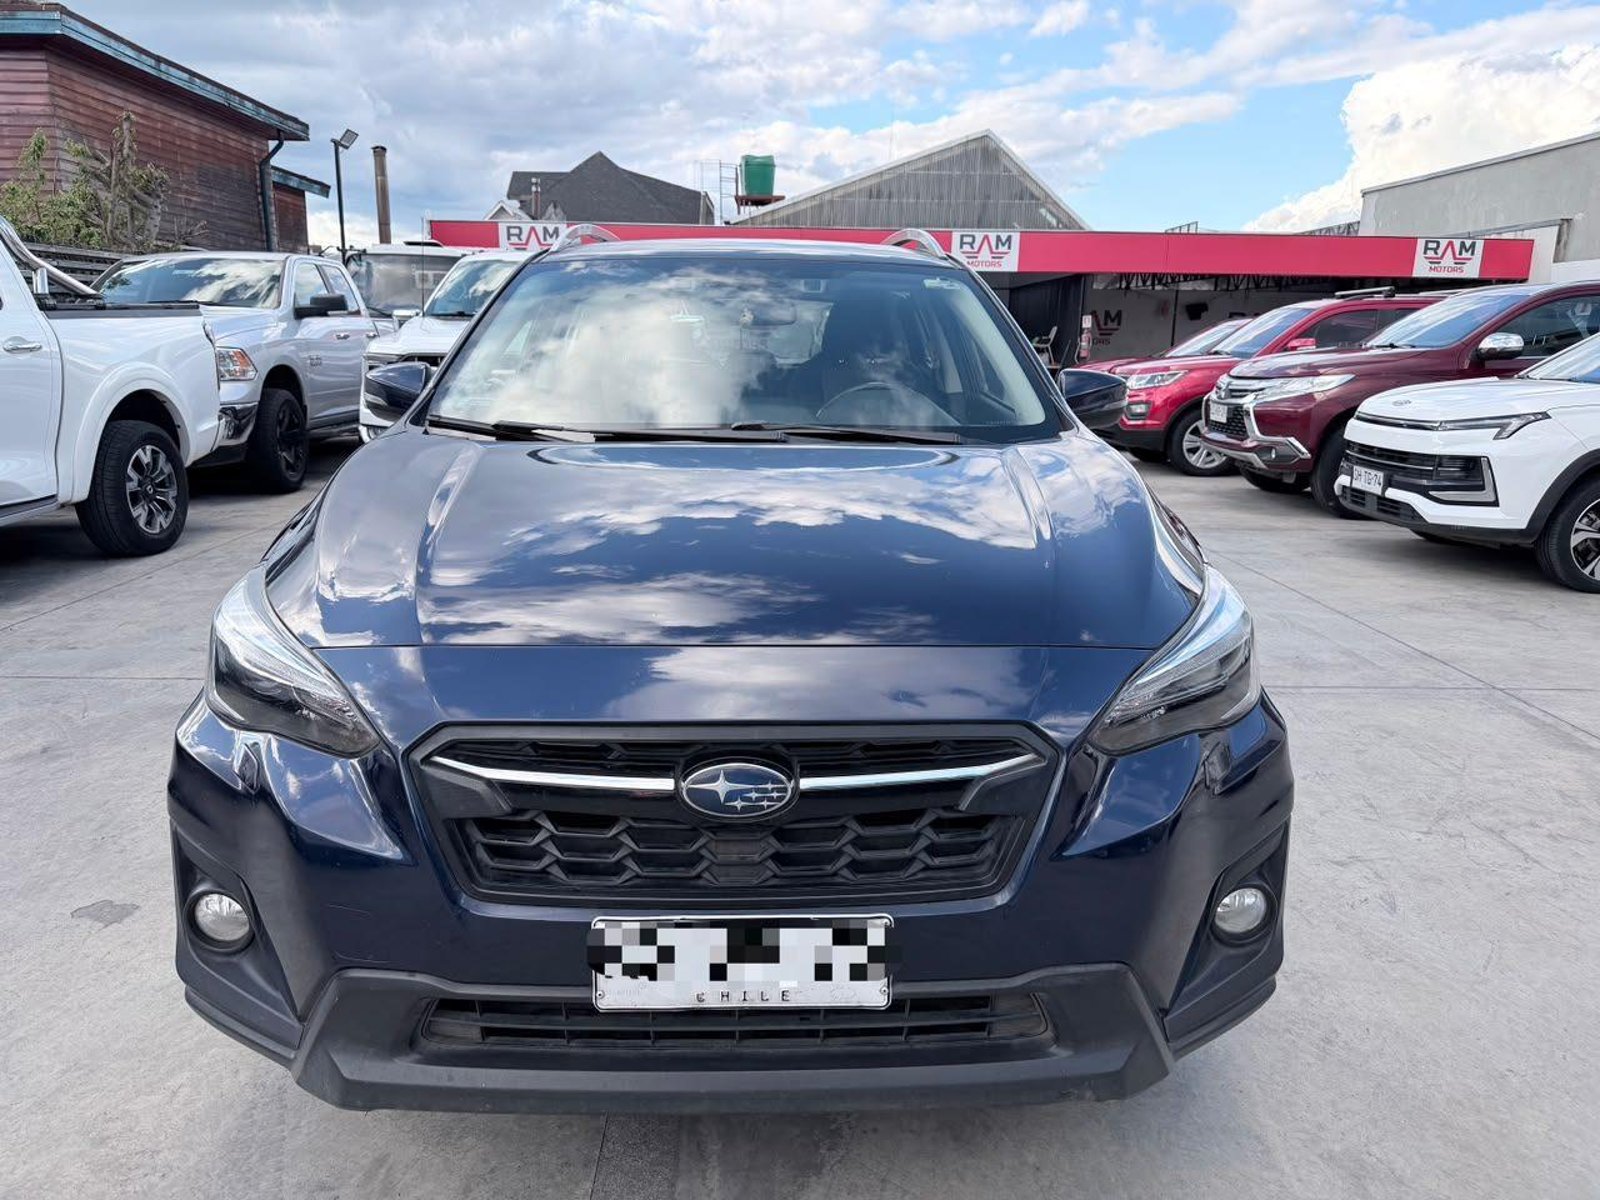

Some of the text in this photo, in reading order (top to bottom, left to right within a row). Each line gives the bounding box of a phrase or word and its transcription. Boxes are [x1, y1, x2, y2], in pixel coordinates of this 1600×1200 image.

[506, 225, 560, 244] RAM
[960, 233, 1012, 252] RAM
[1423, 240, 1477, 258] RAM
[966, 260, 1003, 269] MOTORS
[1428, 265, 1465, 274] MOTORS
[695, 989, 791, 1003] CHILE
